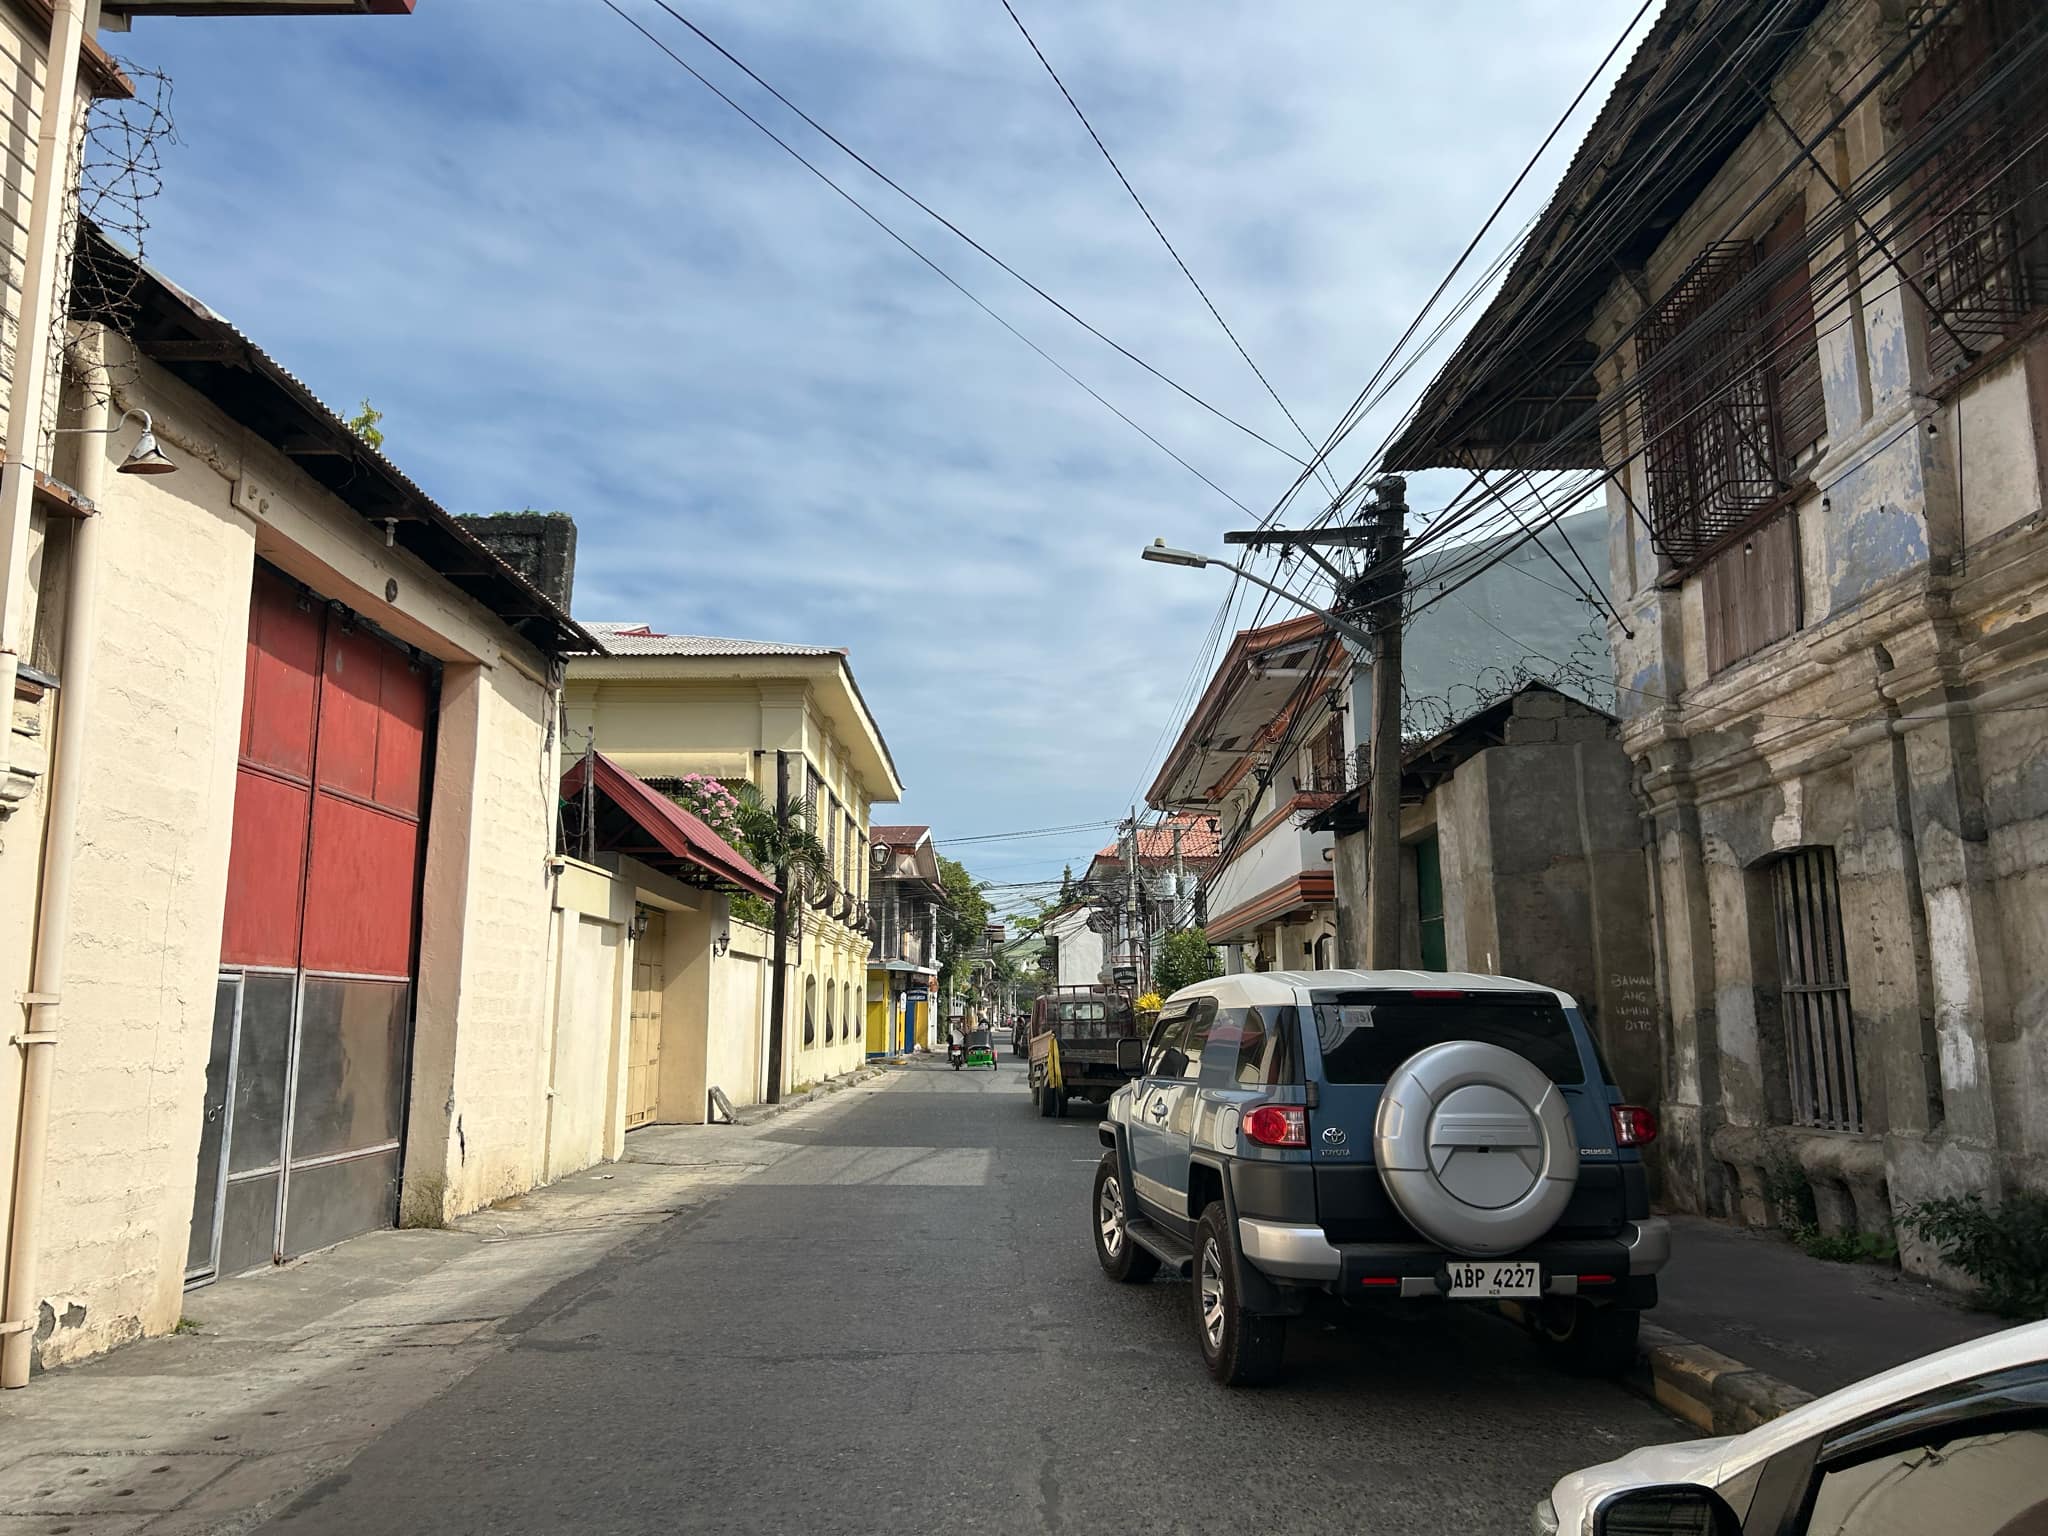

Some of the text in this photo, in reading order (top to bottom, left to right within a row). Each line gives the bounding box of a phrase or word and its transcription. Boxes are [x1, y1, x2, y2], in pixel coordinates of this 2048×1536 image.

[1611, 974, 1651, 987] BAWAL
[1454, 1268, 1535, 1288] ABP 4227
